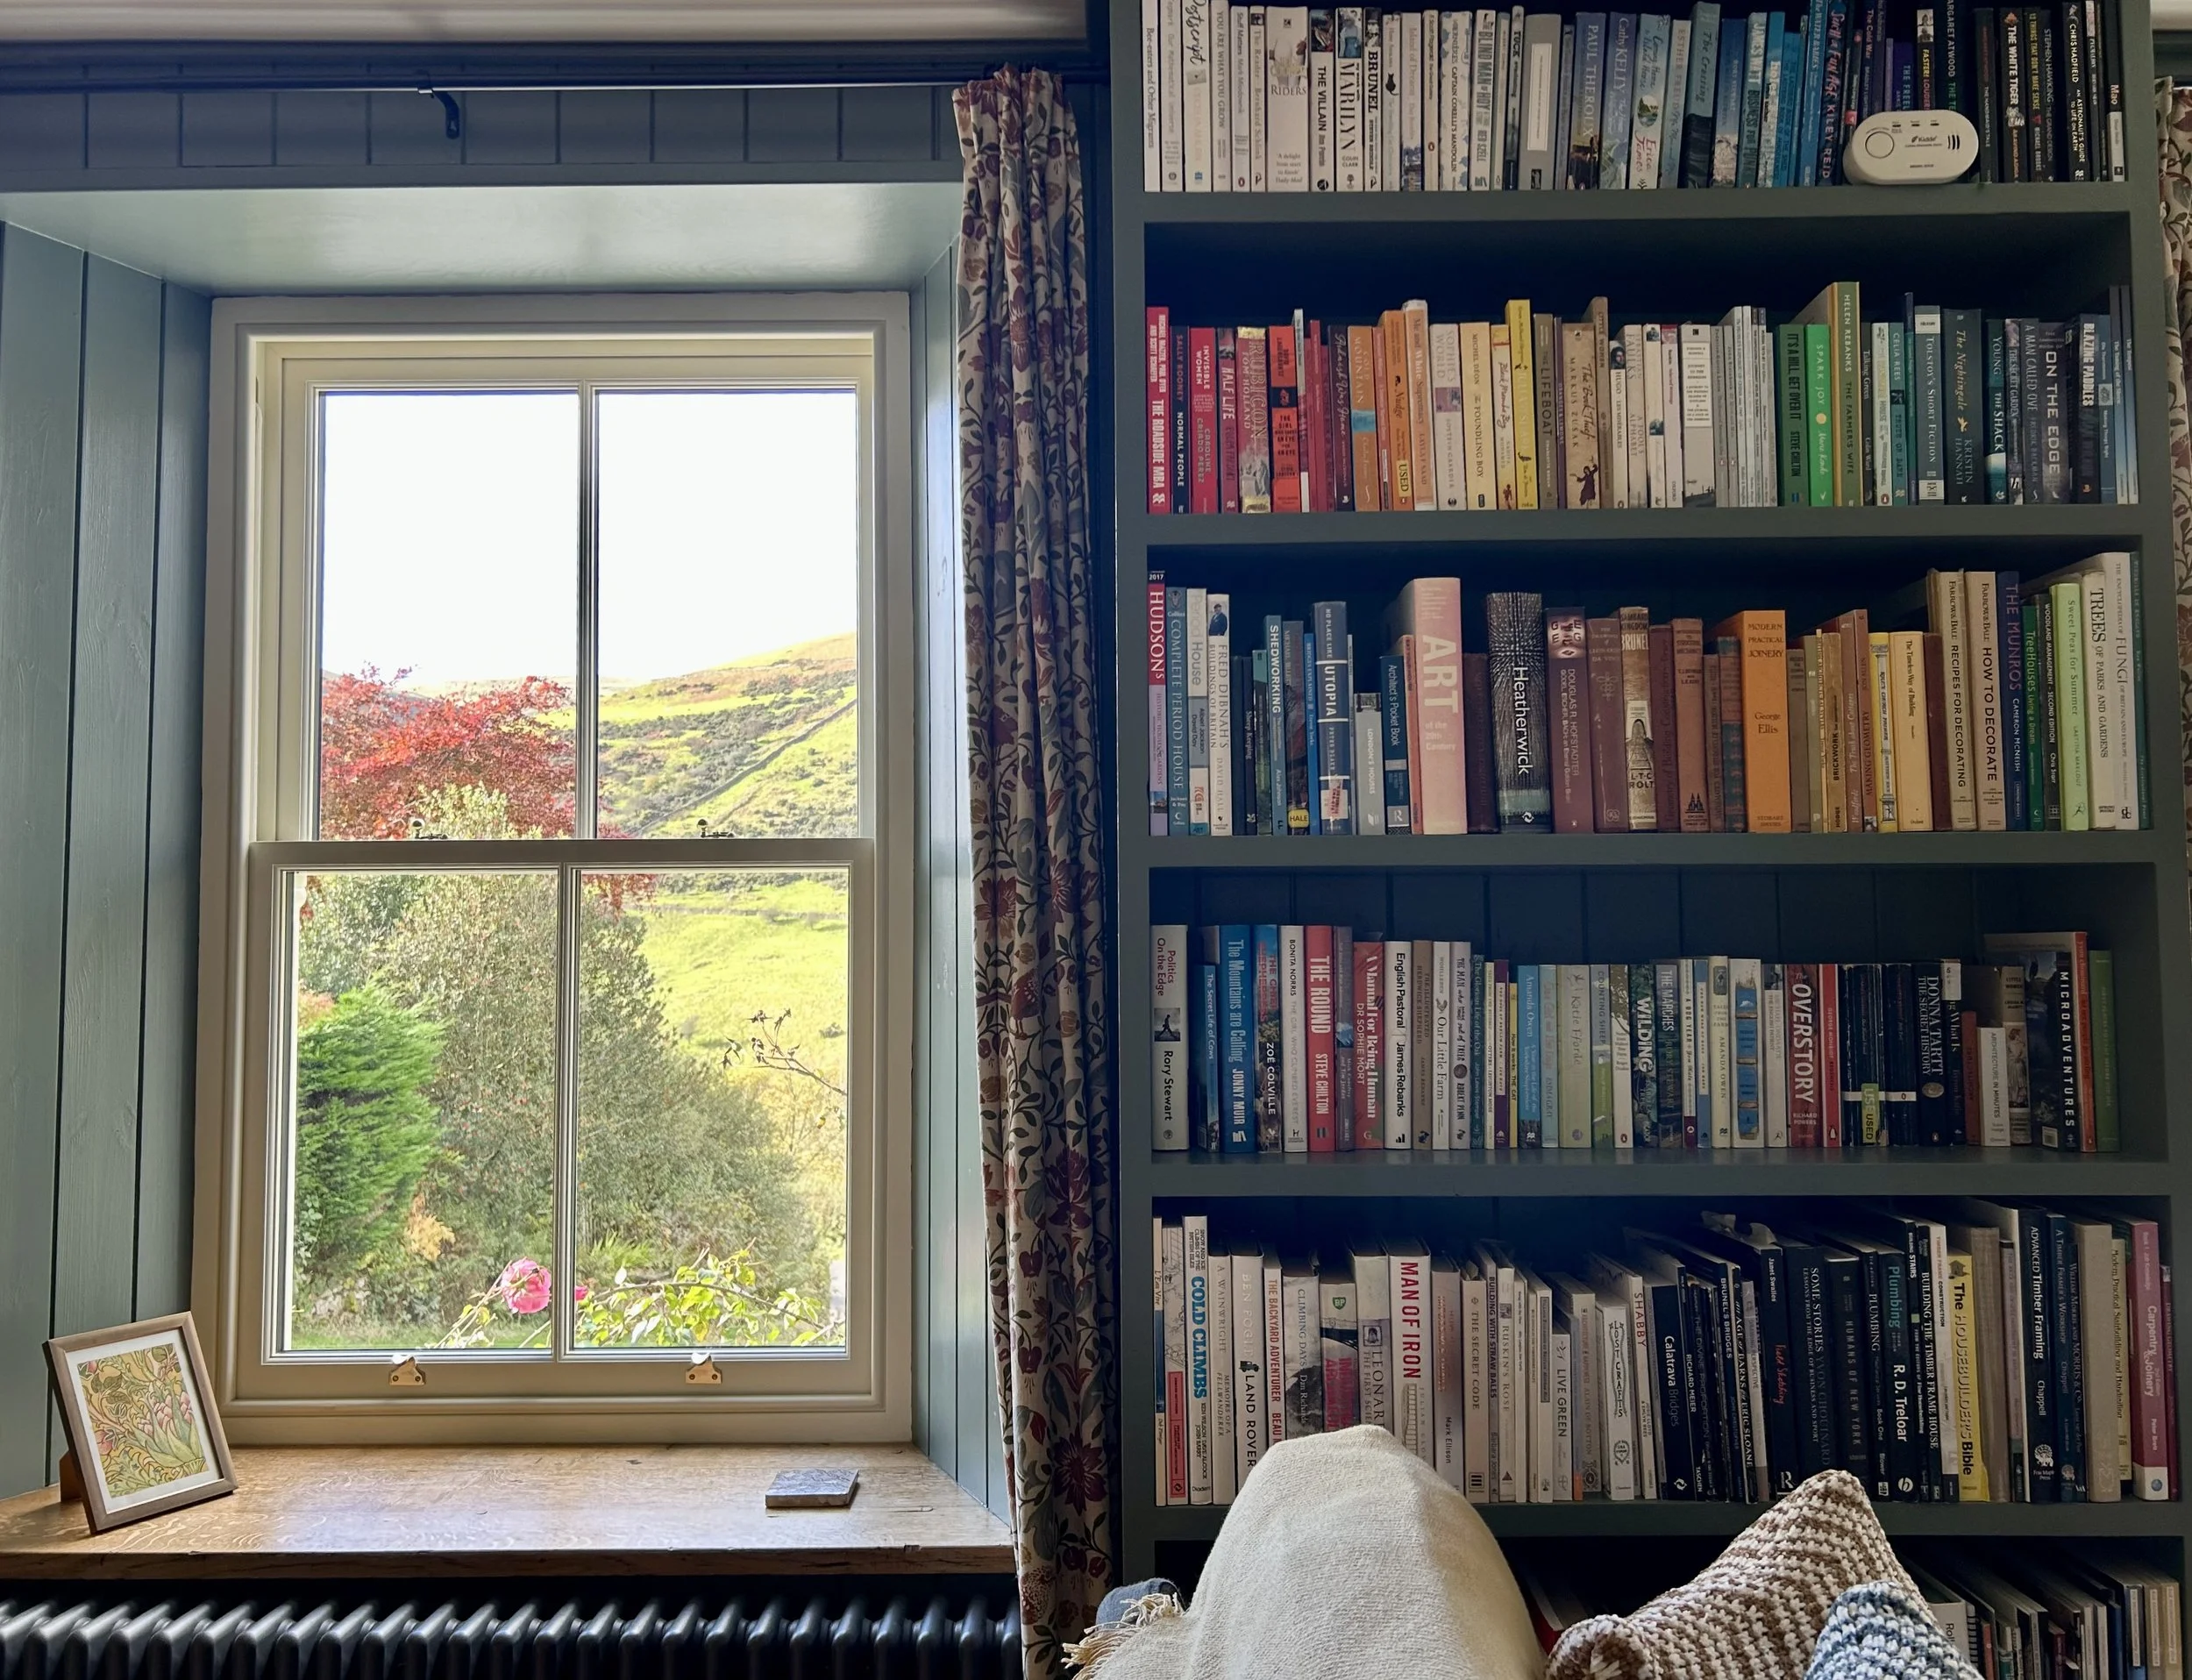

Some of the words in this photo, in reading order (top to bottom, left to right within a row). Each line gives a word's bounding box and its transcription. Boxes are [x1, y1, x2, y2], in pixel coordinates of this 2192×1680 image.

[1586, 25, 1599, 61] PAUL
[2007, 25, 2017, 45] THE
[2008, 46, 2018, 75] WHITE
[1270, 84, 1307, 96] RIDERS
[1368, 51, 1378, 113] BRUNEL
[2010, 77, 2018, 105] TIGER
[2110, 84, 2119, 105] Mao
[1340, 63, 1356, 151] MARILYN
[1583, 65, 1597, 138] THEROUX
[1956, 330, 1966, 349] The
[1993, 336, 2002, 375] YOUNG
[2082, 323, 2095, 363] BLAZING
[1925, 336, 1936, 386] TOLSTOY'S
[2045, 351, 2057, 377] ON
[1222, 367, 1235, 394] HALF
[1249, 341, 1268, 439] RUBICON
[1954, 352, 1967, 411] Nightingale
[2082, 366, 2096, 407] PADDLES
[1152, 399, 1164, 417] THE
[1222, 396, 1235, 420] LIFE
[1927, 389, 1936, 420] SHORT
[2046, 383, 2059, 419] THE
[1152, 419, 1164, 464] ROADSIDE
[1928, 424, 1937, 463] FICTION
[1994, 410, 2005, 452] SHACK
[2047, 425, 2060, 474] EDGE
[1152, 466, 1165, 488] MBA
[1398, 464, 1409, 492] USED
[1954, 438, 1964, 485] HANNAH
[1964, 439, 1973, 483] KRISTIN
[1747, 623, 1783, 631] MODERN
[2089, 587, 2106, 643] TREES
[1171, 620, 1182, 687] COMPLETE
[1218, 644, 1228, 678] FRED
[1270, 624, 1282, 714] SHEDWORKING
[1747, 650, 1783, 658] JOINERY
[1951, 644, 1961, 689] RECIPES
[1982, 647, 1992, 681] HOW
[2026, 631, 2037, 692] TreeHouses
[2096, 646, 2103, 658] OF
[1324, 666, 1336, 716] UTOPIA
[1388, 664, 1399, 701] Architect's
[1422, 635, 1459, 714] ART
[2096, 661, 2105, 691] PARKS
[1953, 692, 1962, 715] FOR
[1984, 685, 1994, 704] TO
[2097, 694, 2107, 713] AND
[1172, 692, 1182, 741] PERIOD
[1219, 683, 1229, 749] DIBNAH'S
[1389, 703, 1399, 729] Pocket
[1513, 666, 1534, 775] Heatherwick
[1758, 723, 1779, 735] Ellis
[1391, 730, 1400, 746] Book
[1954, 717, 1966, 787] DECORATING
[1985, 707, 1996, 781] DECORATE
[2099, 716, 2108, 758] GARDENS
[1173, 745, 1184, 789] HOUSE
[1157, 937, 1166, 954] On
[1228, 939, 1244, 957] The
[1155, 972, 1165, 996] Edge
[1167, 950, 1176, 984] Politics
[1228, 960, 1245, 1009] Mountains
[1310, 955, 1330, 982] THE
[1395, 952, 1406, 988] English
[1918, 976, 1926, 995] THE
[1310, 987, 1331, 1034] ROUND
[1396, 989, 1406, 1029] Pastoral
[1919, 997, 1928, 1034] SECRET
[1926, 976, 1941, 1025] DONNA
[1229, 1013, 1242, 1027] are
[1436, 1016, 1447, 1037] Our
[1636, 997, 1653, 1072] WILDING
[1161, 1050, 1173, 1075] Rory
[1228, 1029, 1247, 1063] Calling
[1436, 1041, 1447, 1070] Little
[1791, 984, 1814, 1104] OVERSTORY
[1920, 1035, 1931, 1076] HISTORY
[1931, 1029, 1943, 1076] TARTT
[2060, 972, 2075, 1127] MICROADVENTURES
[1232, 1068, 1244, 1098] JONNY
[1315, 1053, 1328, 1078] STEVE
[1164, 1078, 1173, 1121] Stewart
[1316, 1080, 1329, 1114] CHILTON
[1397, 1074, 1406, 1117] Rebanks
[1436, 1072, 1447, 1100] Farm
[1233, 1101, 1245, 1125] MUIR
[1865, 1114, 1875, 1140] USED
[2030, 1226, 2040, 1273] ADVANCED
[1400, 1262, 1419, 1301] MAN
[1886, 1265, 1903, 1328] Plumbing
[1921, 1271, 1932, 1319] BUILDING
[1954, 1283, 1966, 1310] The
[2032, 1273, 2044, 1313] Timber
[1192, 1276, 1206, 1326] COLD
[1401, 1306, 1420, 1328] OF
[1634, 1292, 1646, 1347] SHABBY
[1868, 1292, 1880, 1352] PLUMBING
[1924, 1322, 1932, 1342] THE
[2032, 1314, 2045, 1360] Framing
[1192, 1328, 1207, 1399] CLIMBS
[1402, 1333, 1422, 1378] IRON
[1471, 1335, 1480, 1376] SECRET
[1664, 1335, 1676, 1386] Calatrava
[1893, 1364, 1905, 1377] R.
[1925, 1343, 1934, 1378] TIMBER
[1245, 1375, 1256, 1413] LAND
[1472, 1379, 1481, 1411] CODE
[1556, 1368, 1567, 1395] LIVE
[1894, 1380, 1906, 1394] D.
[1954, 1314, 1973, 1439] HOUSEBUILDER'S
[1667, 1389, 1680, 1427] Bridges
[1927, 1381, 1936, 1414] FRAME
[2036, 1379, 2046, 1416] Chappell
[1557, 1397, 1568, 1437] GREEN
[1895, 1397, 1909, 1442] Treloar
[1928, 1416, 1939, 1449] HOUSE
[1246, 1420, 1257, 1468] ROVER
[1961, 1442, 1974, 1476] Bible
